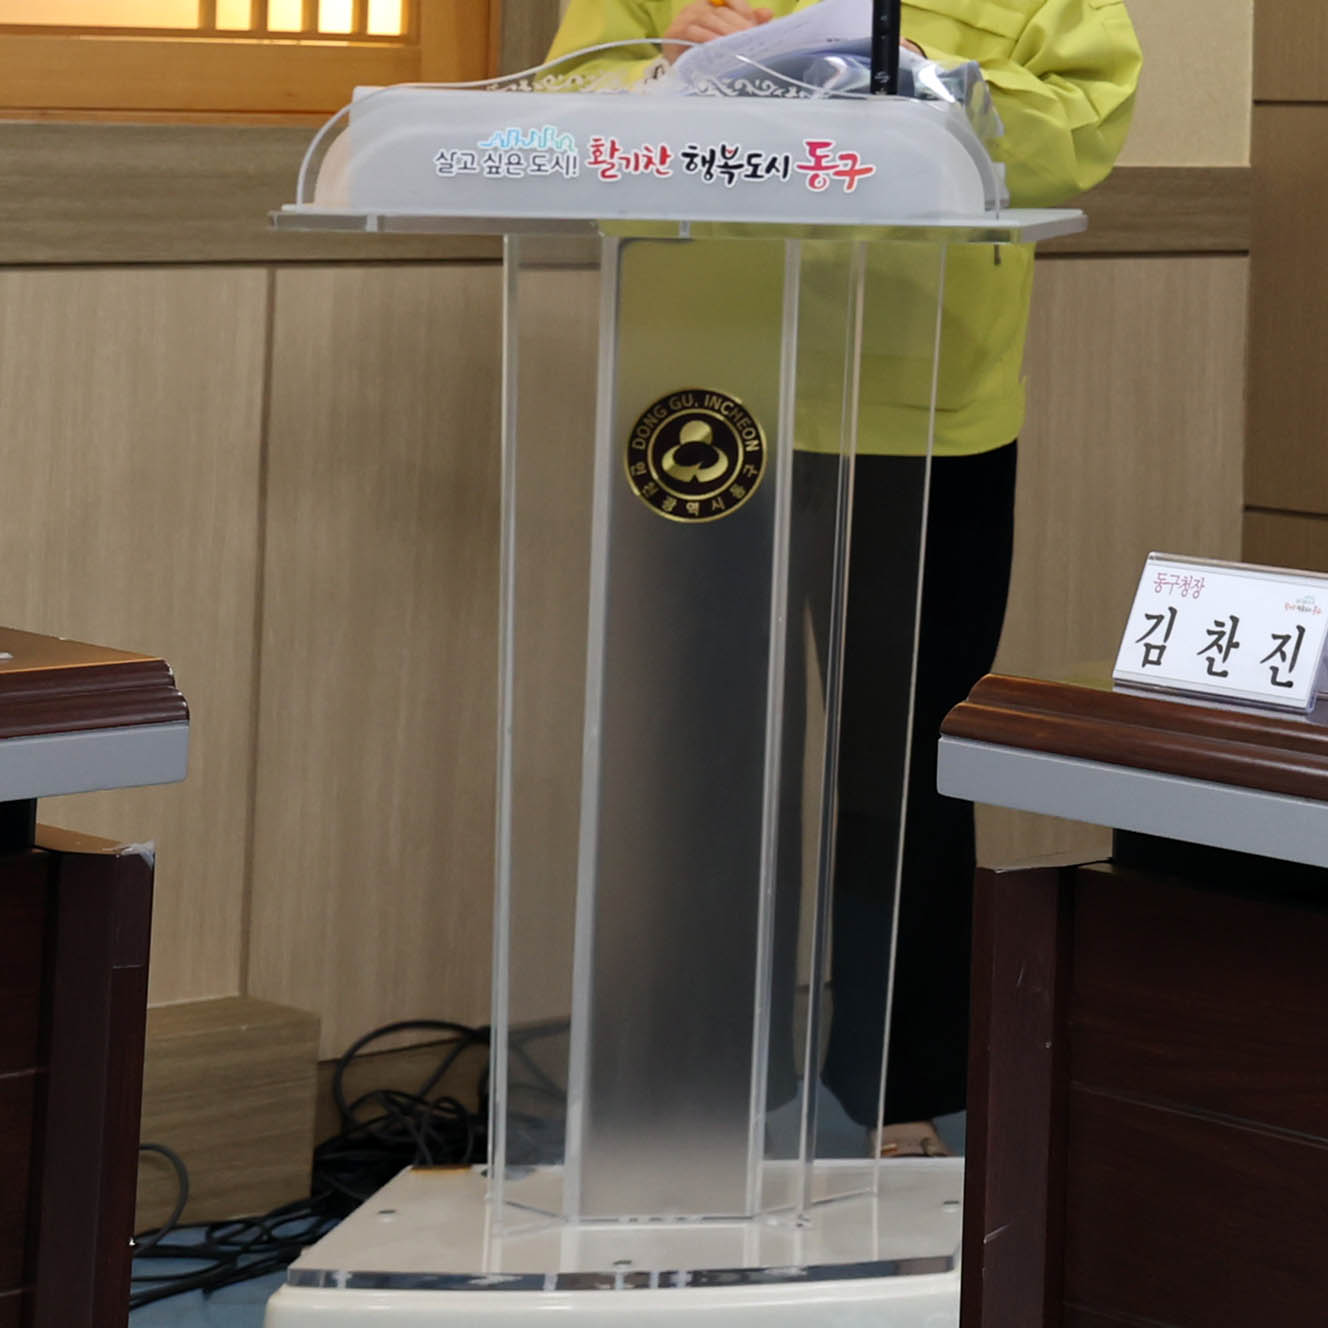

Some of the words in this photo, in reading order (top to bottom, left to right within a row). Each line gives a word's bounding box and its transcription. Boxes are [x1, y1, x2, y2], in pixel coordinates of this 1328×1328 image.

[435, 151, 477, 176] 살고
[483, 151, 525, 176] 싶은
[529, 152, 578, 177] 도시!
[587, 137, 672, 180] 활기찬
[680, 143, 791, 186] 행복도시
[796, 140, 875, 191] 동구
[631, 404, 668, 451] DONG
[704, 393, 761, 453] INCHEON
[1153, 571, 1207, 600] 동구청장
